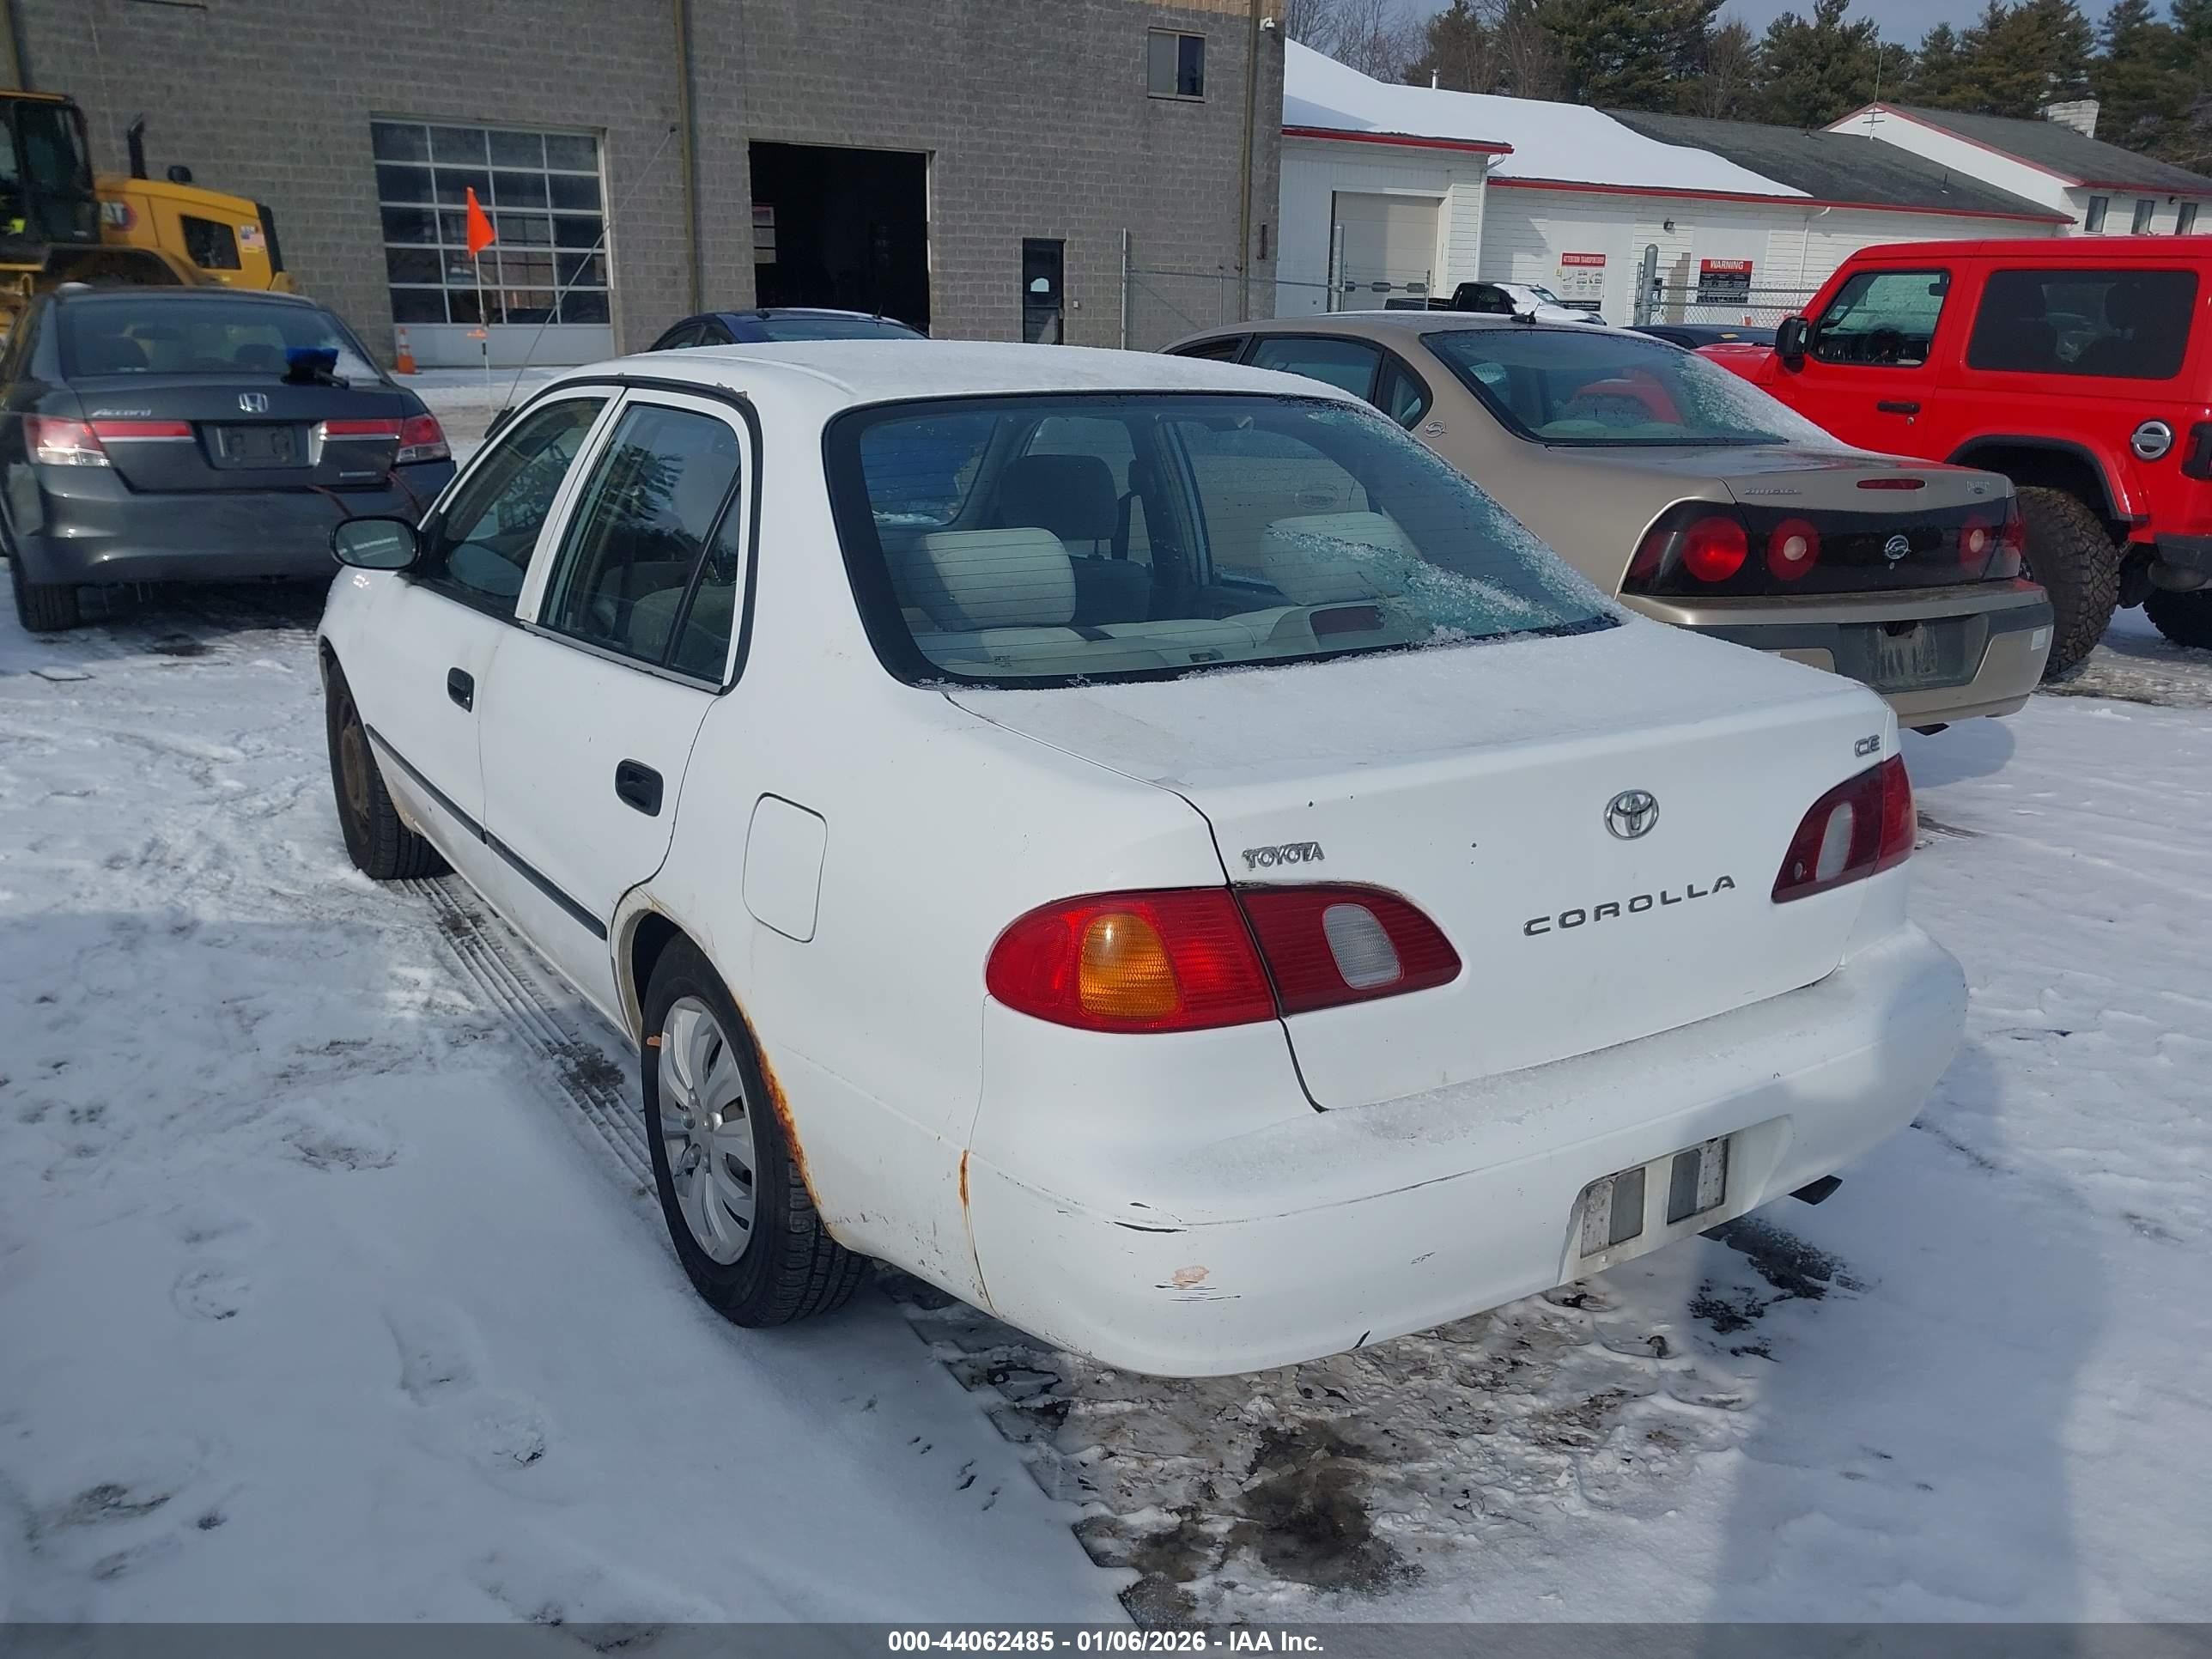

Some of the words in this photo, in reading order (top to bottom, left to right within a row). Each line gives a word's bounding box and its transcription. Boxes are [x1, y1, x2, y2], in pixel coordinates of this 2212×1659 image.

[1710, 260, 1744, 270] WARNING
[1855, 734, 1881, 757] CE
[1242, 842, 1325, 869] TOYOTA
[1523, 875, 1735, 936] COROLLA
